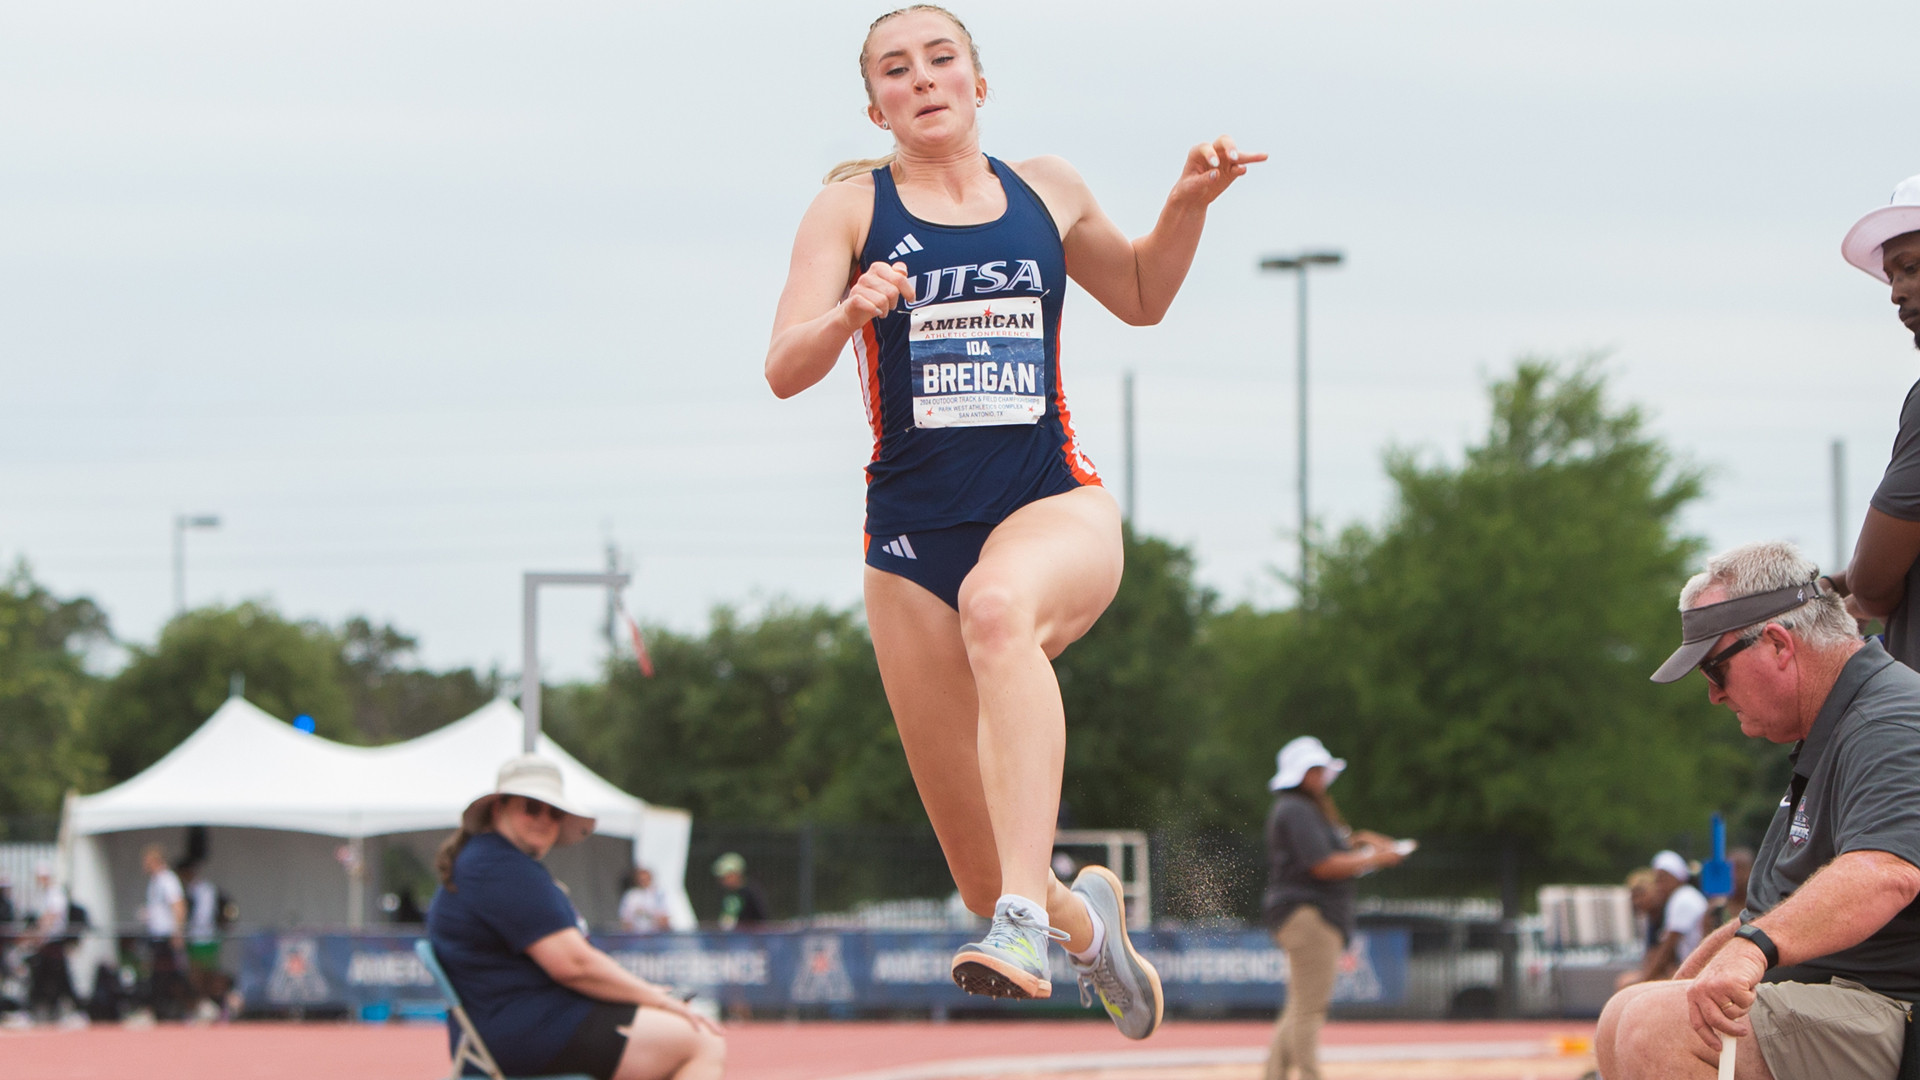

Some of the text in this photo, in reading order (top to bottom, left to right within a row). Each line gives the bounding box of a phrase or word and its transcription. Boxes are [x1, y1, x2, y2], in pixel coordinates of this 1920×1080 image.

[904, 259, 1044, 310] UTSA
[919, 313, 1035, 331] AMERICAN
[924, 332, 968, 340] ATHLETIC
[966, 340, 991, 356] IDA
[922, 361, 1036, 394] BREIGAN
[932, 397, 958, 405] OUTDOOR
[998, 395, 1040, 405] CHAMPIONSHIPS
